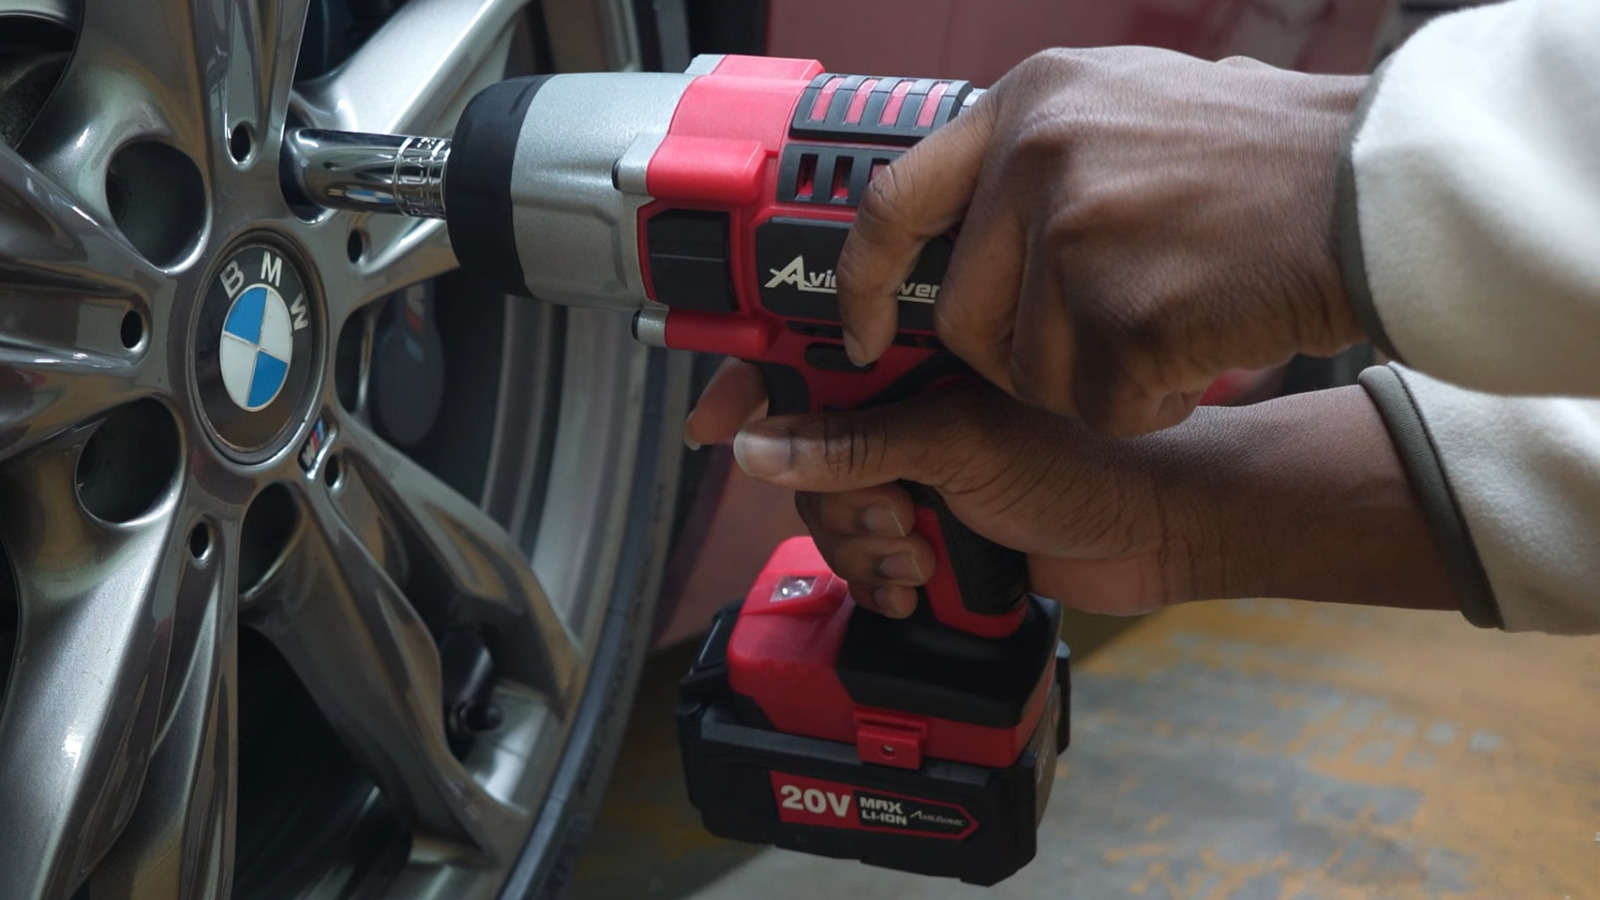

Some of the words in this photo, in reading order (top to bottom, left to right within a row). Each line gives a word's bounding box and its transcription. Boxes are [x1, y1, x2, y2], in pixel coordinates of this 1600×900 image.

[219, 251, 309, 331] BMW
[780, 784, 851, 817] 20V
[859, 796, 903, 814] MAX
